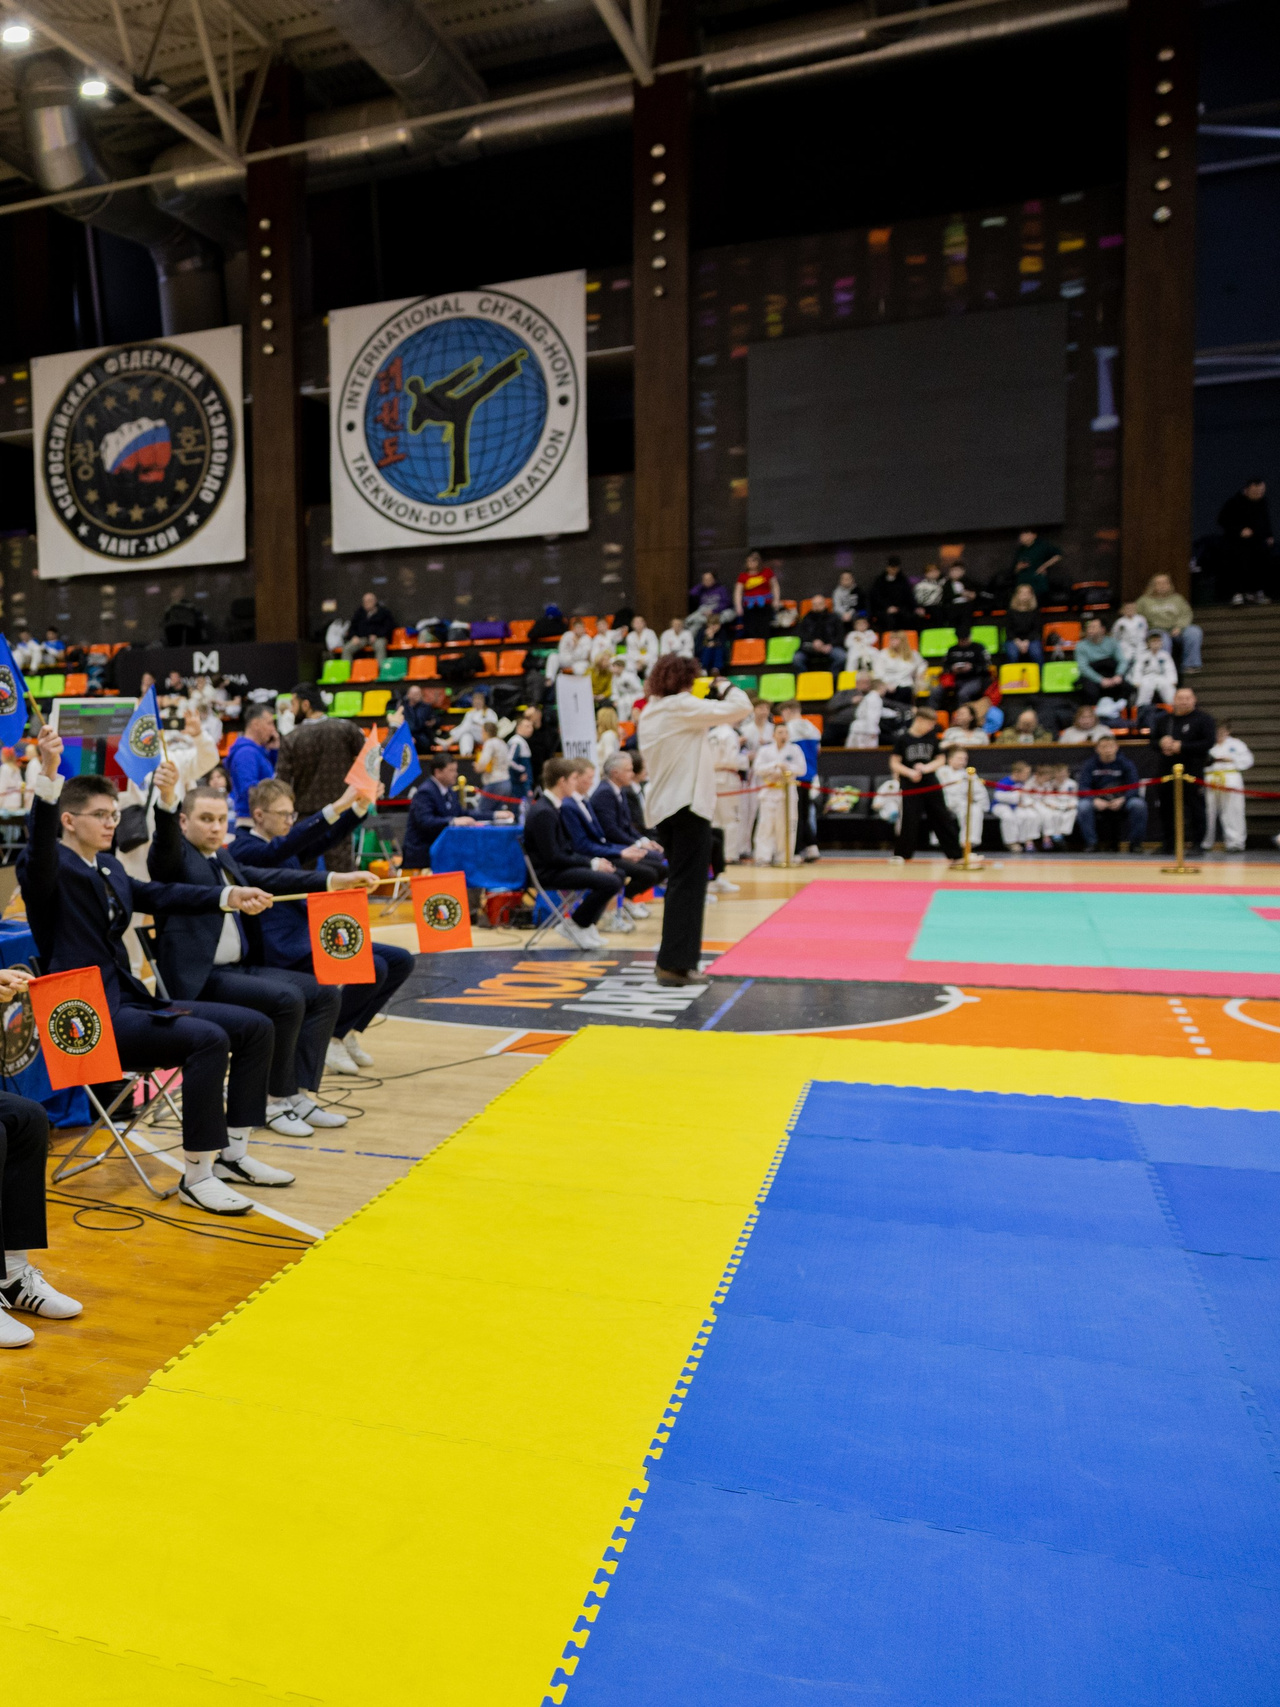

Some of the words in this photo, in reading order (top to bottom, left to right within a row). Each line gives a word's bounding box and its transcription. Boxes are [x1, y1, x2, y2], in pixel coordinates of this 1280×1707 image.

[346, 297, 465, 410] INTERNATIONAL
[478, 297, 572, 389] CH'ANG-HON
[47, 371, 98, 520] ВСЕРОССИЙСКАЯ
[103, 349, 204, 392] ФЕДЕРАЦИЯ
[198, 389, 229, 505] ТХЭКВОНДО
[351, 451, 457, 526] TAEKWON-DO
[464, 428, 566, 524] FEDERATION
[97, 525, 180, 557] ЧАНГ-ХОН
[416, 960, 620, 1009] NOVA
